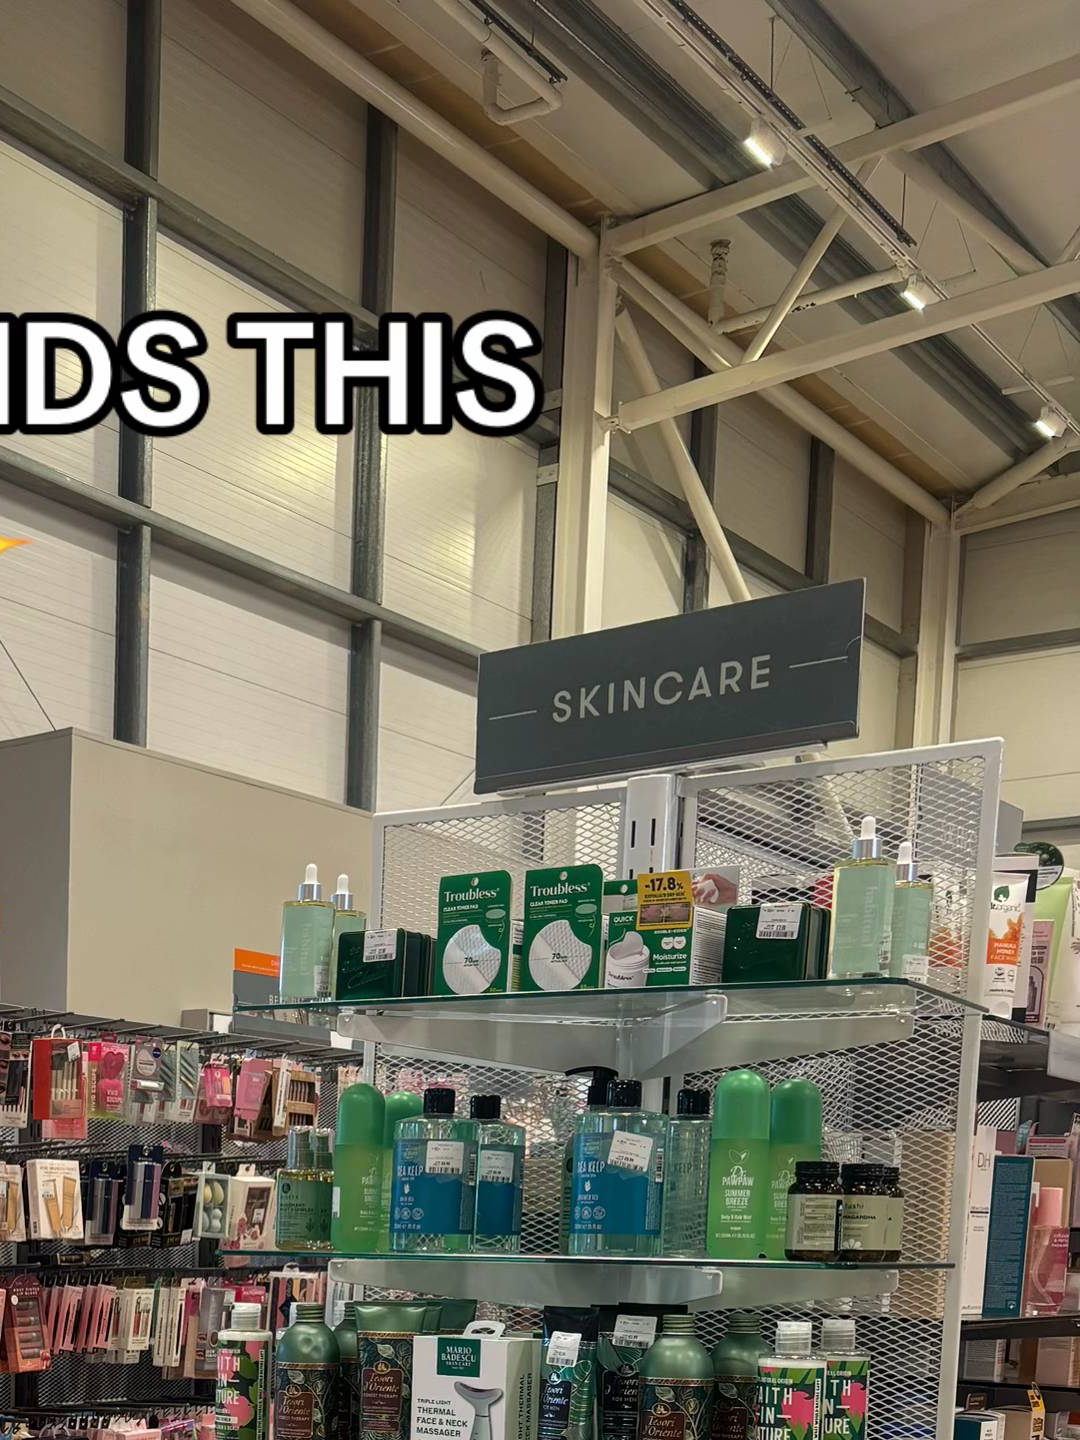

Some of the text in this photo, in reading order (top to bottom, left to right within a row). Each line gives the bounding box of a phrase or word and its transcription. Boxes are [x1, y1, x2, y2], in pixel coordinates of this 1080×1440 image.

[551, 654, 771, 724] SKINCARE
[529, 882, 588, 897] Troubless
[444, 888, 497, 903] Troubless
[446, 1345, 472, 1355] MARIO
[441, 1353, 476, 1363] BADESCU
[435, 1399, 451, 1407] LIGHT
[417, 1406, 456, 1417] THERMAL
[416, 1417, 468, 1428] FACE & NECK
[416, 1427, 461, 1438] MASSAGER
